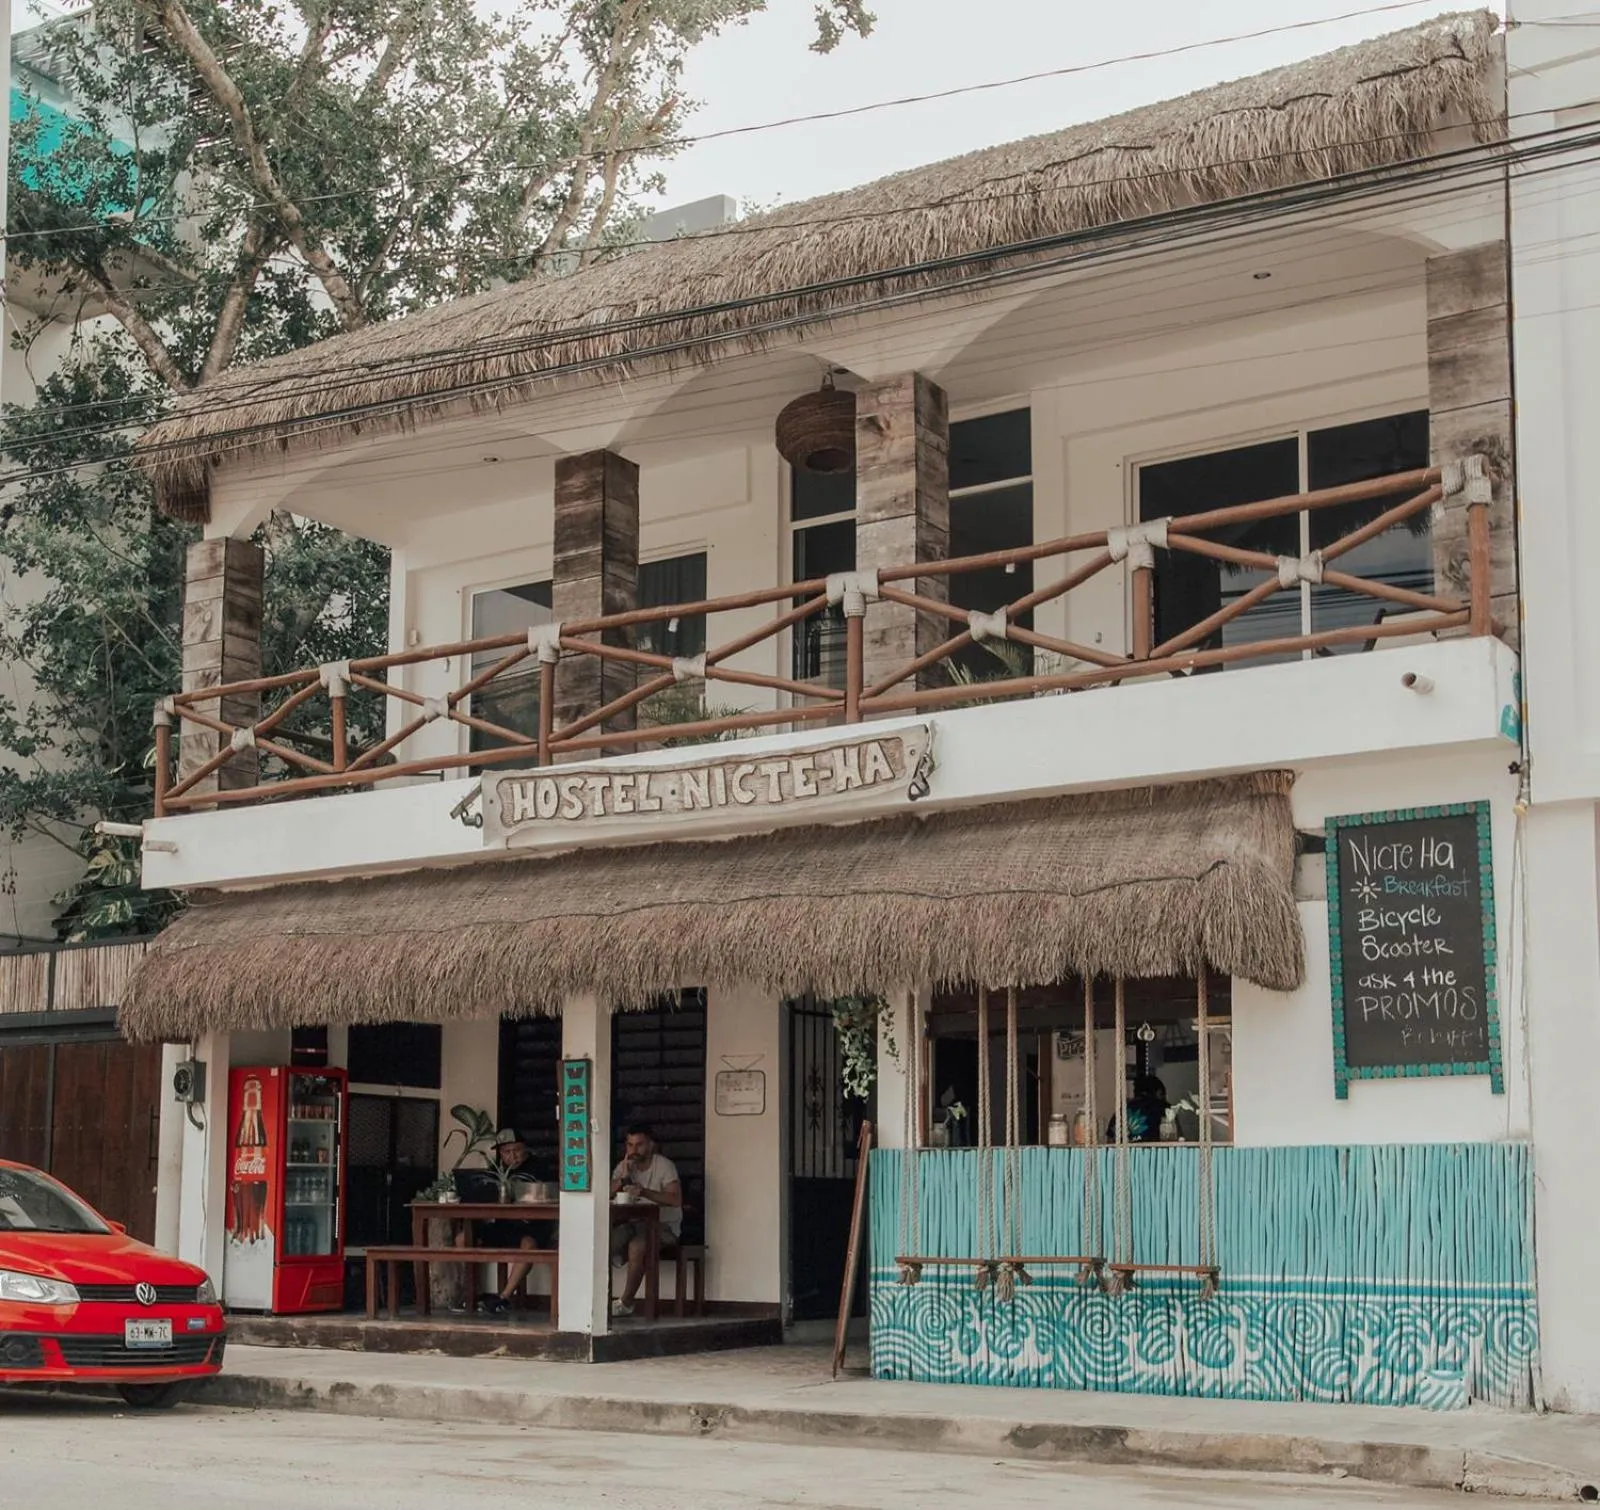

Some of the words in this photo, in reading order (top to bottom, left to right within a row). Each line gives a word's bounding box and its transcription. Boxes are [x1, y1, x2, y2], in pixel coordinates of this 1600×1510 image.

[511, 771, 662, 822] HOSTEL
[682, 741, 896, 810] NICTE-HA
[1357, 904, 1441, 935] Bicycle
[1403, 970, 1415, 989] 4
[1421, 965, 1457, 986] the
[1355, 986, 1478, 1022] PROMOS
[565, 1067, 586, 1184] VACANCY
